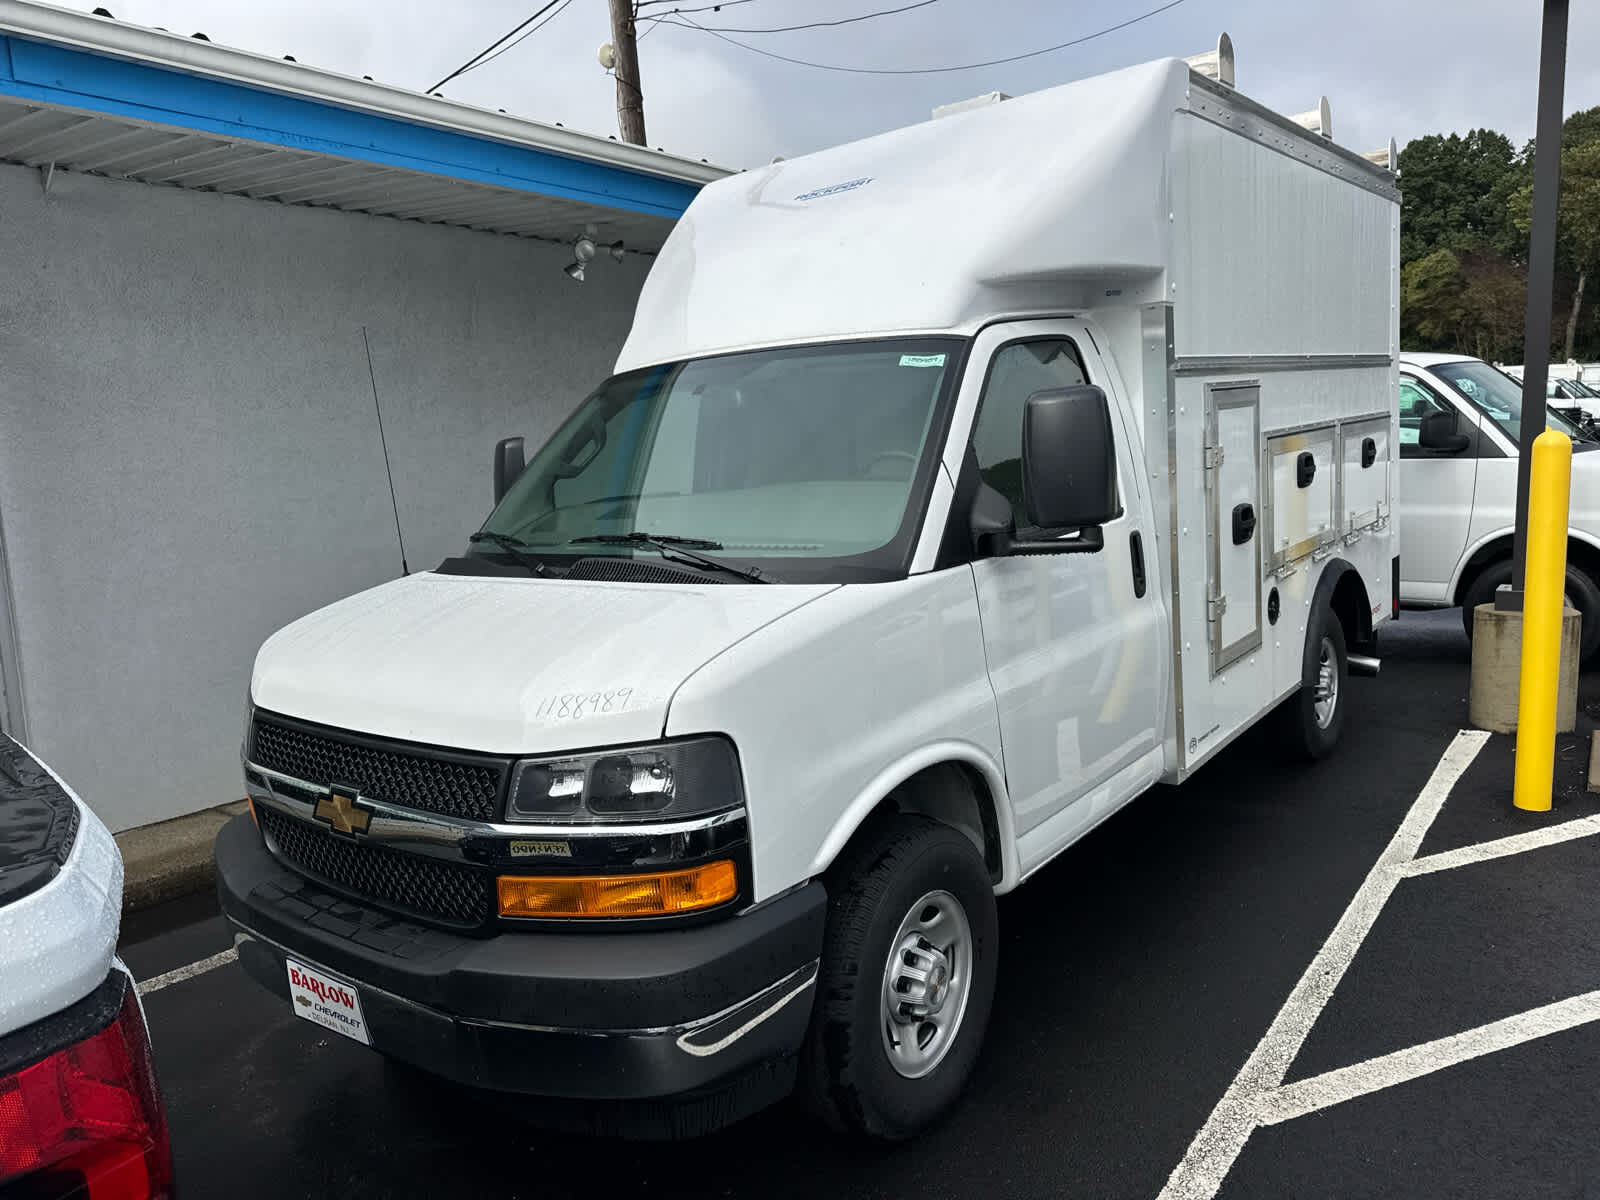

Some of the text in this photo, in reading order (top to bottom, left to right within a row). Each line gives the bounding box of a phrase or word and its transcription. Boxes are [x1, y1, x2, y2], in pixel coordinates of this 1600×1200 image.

[794, 177, 876, 201] ROCKPORT
[536, 688, 633, 719] 1188989
[290, 968, 354, 1010] BARLOW
[315, 1003, 361, 1028] CHEVROLET
